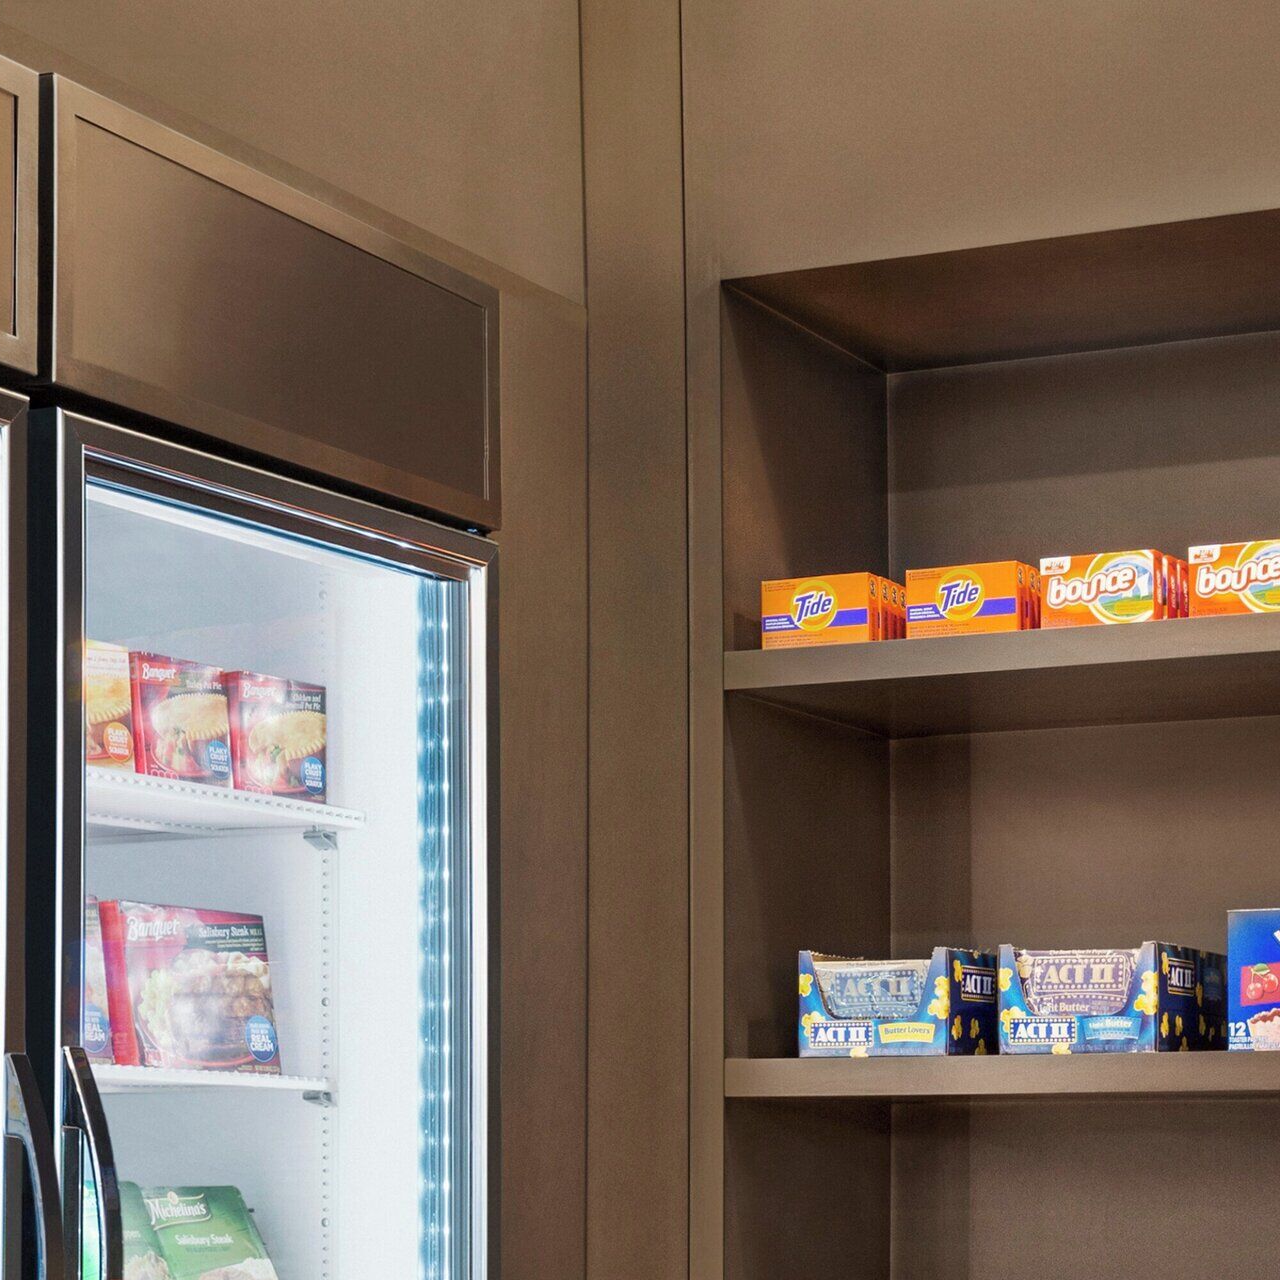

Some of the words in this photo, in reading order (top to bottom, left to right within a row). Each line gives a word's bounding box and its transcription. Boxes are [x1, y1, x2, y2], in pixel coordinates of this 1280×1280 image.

[1049, 568, 1136, 606] bounce
[939, 580, 979, 612] Tide
[794, 591, 833, 623] Tide
[127, 914, 180, 943] Banquet
[198, 927, 231, 940] Salisbury
[231, 925, 249, 936] Steak
[1043, 964, 1086, 985] ACT
[1090, 963, 1115, 984] II
[1171, 967, 1185, 987] ACT
[965, 974, 980, 995] ACT
[980, 974, 993, 995] II
[1059, 1002, 1090, 1012] Butter
[884, 1026, 905, 1035] Butter
[905, 1026, 930, 1035] Lovers
[1015, 1024, 1050, 1039] ACT
[1050, 1023, 1070, 1038] II
[1104, 1019, 1133, 1029] Butter
[1228, 1022, 1246, 1037] 12
[251, 1033, 271, 1043] REAL
[815, 1026, 847, 1043] ACT
[848, 1026, 868, 1042] II
[144, 1199, 208, 1226] Michelina's
[174, 1233, 210, 1247] Salisbury
[210, 1233, 234, 1245] Steak
